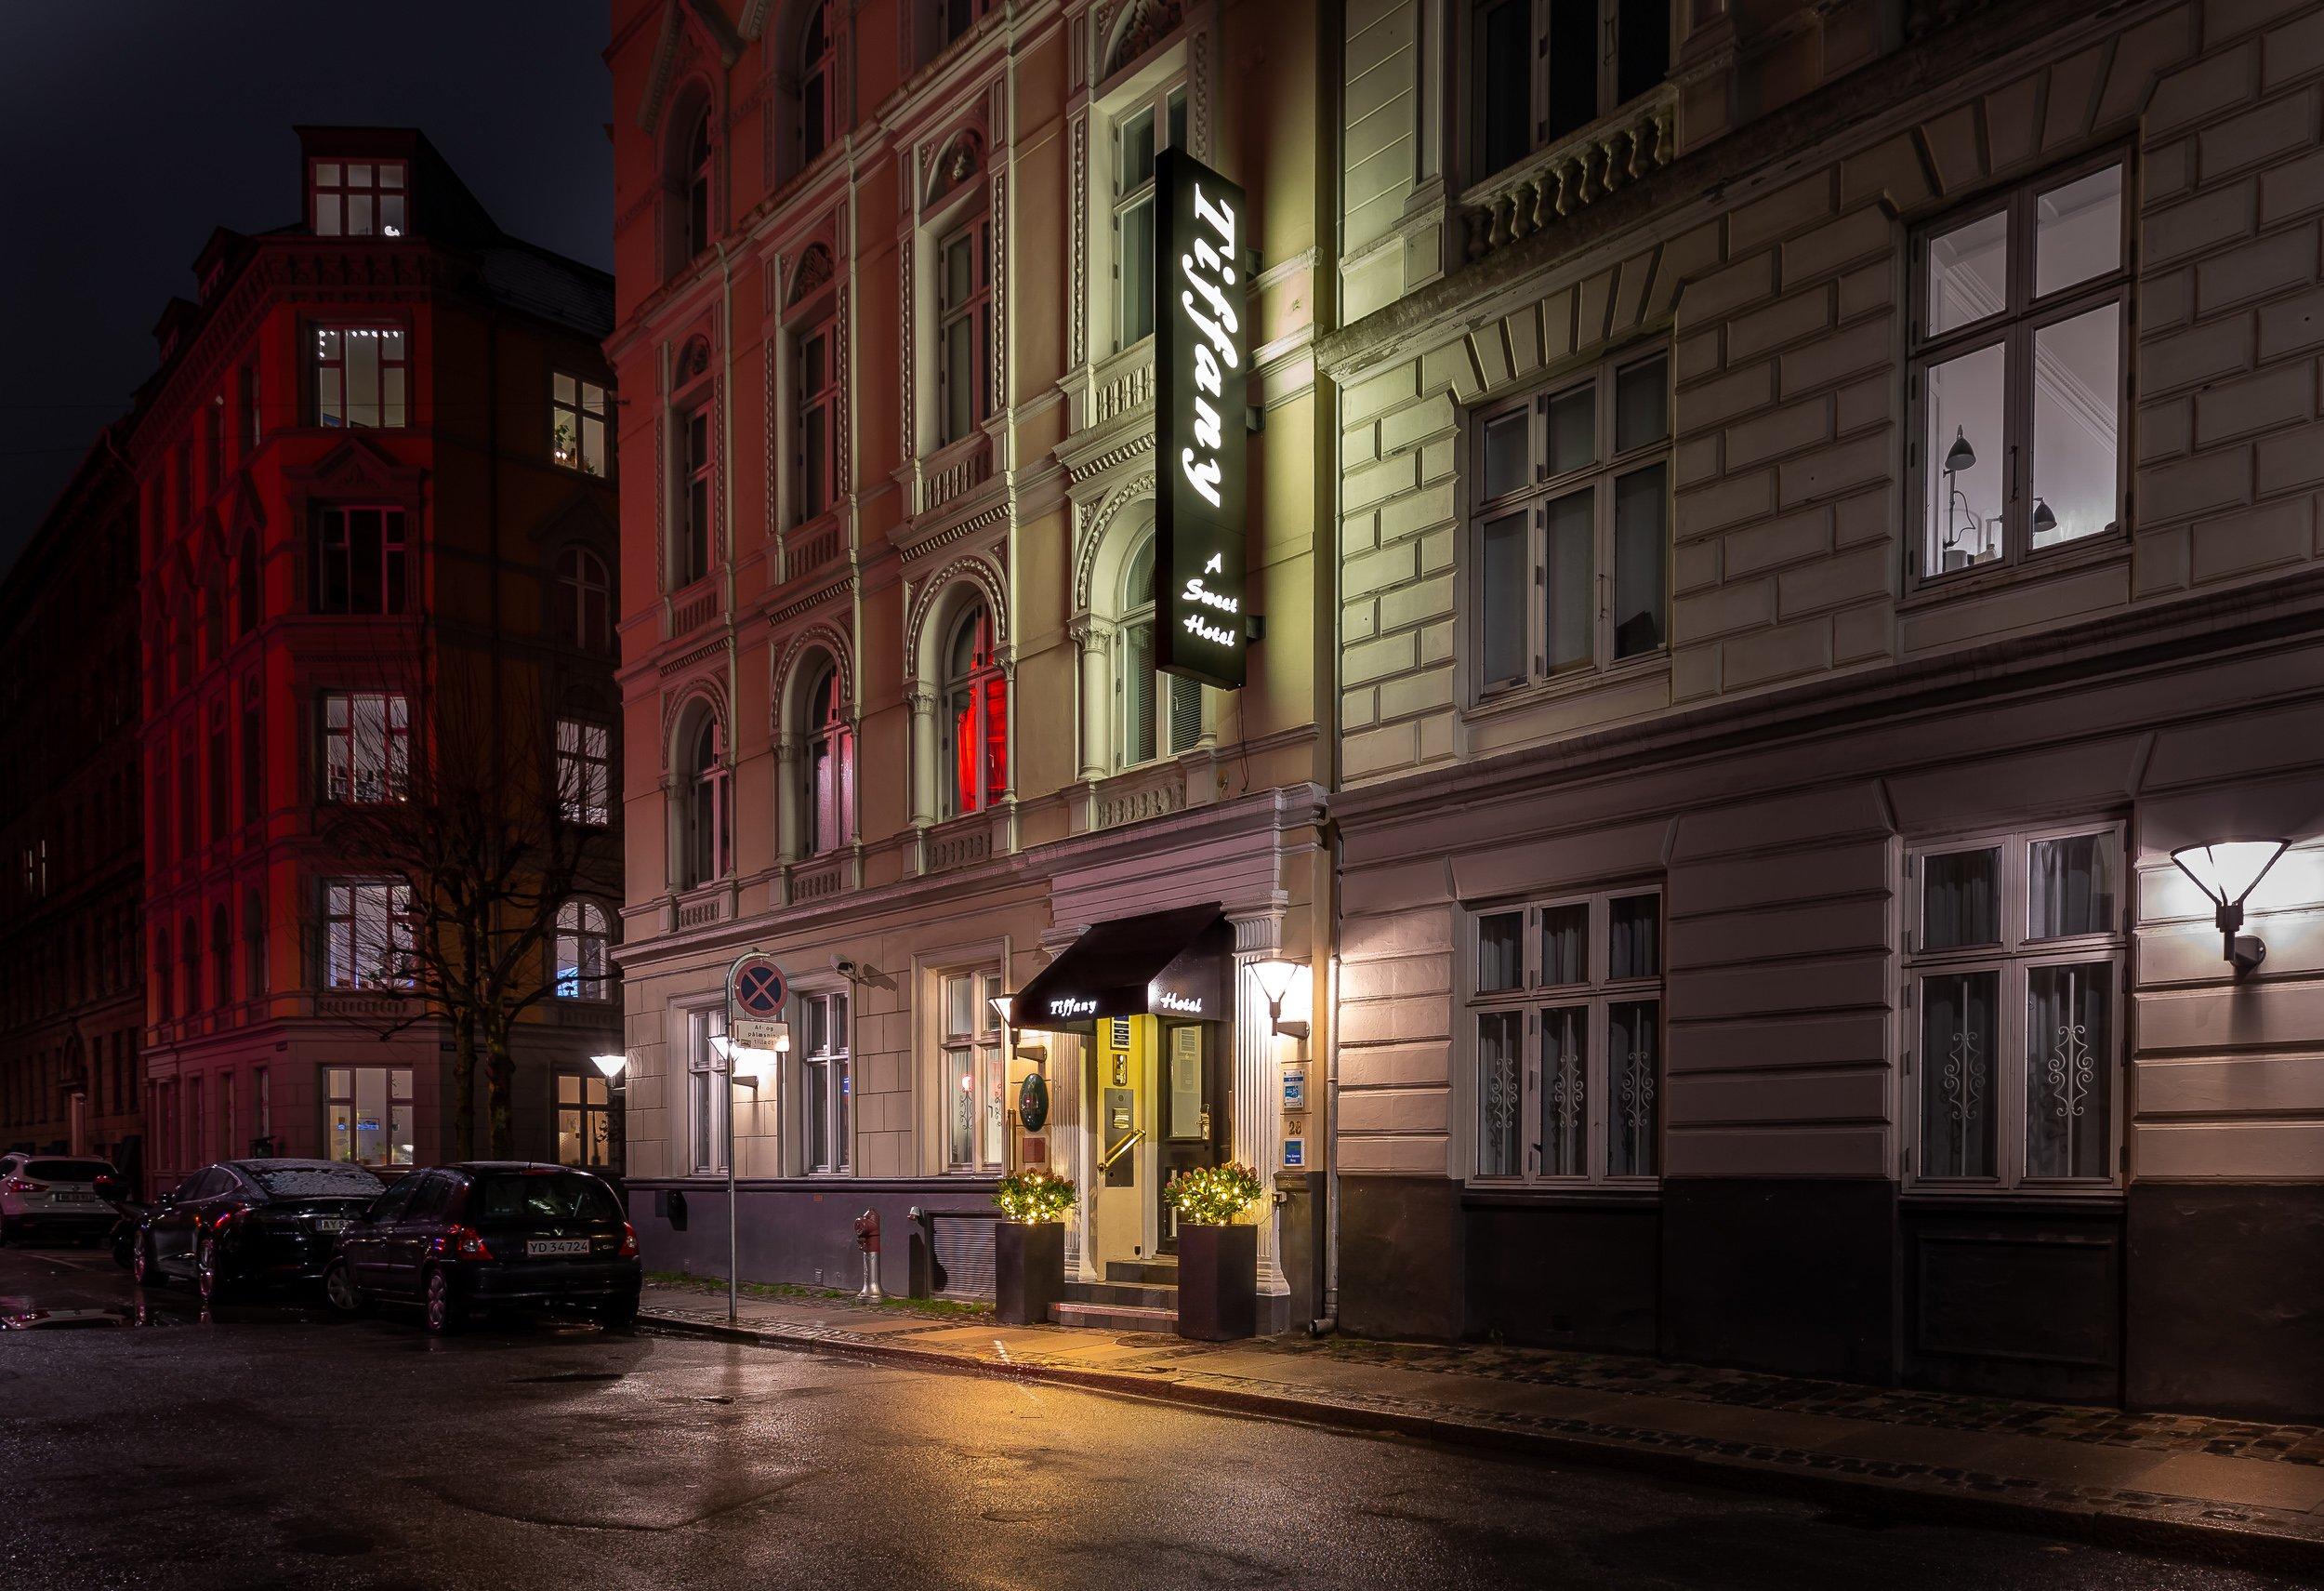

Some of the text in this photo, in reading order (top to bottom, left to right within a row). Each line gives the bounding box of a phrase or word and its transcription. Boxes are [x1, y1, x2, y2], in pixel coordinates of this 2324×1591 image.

[1182, 182, 1239, 508] Tiffany
[1205, 552, 1221, 574] A
[1183, 614, 1235, 646] Hotel
[1050, 998, 1097, 1016] Tiffany
[1159, 992, 1201, 1013] Hotel
[1288, 1120, 1301, 1135] 28
[530, 1241, 588, 1253] YD 34724
